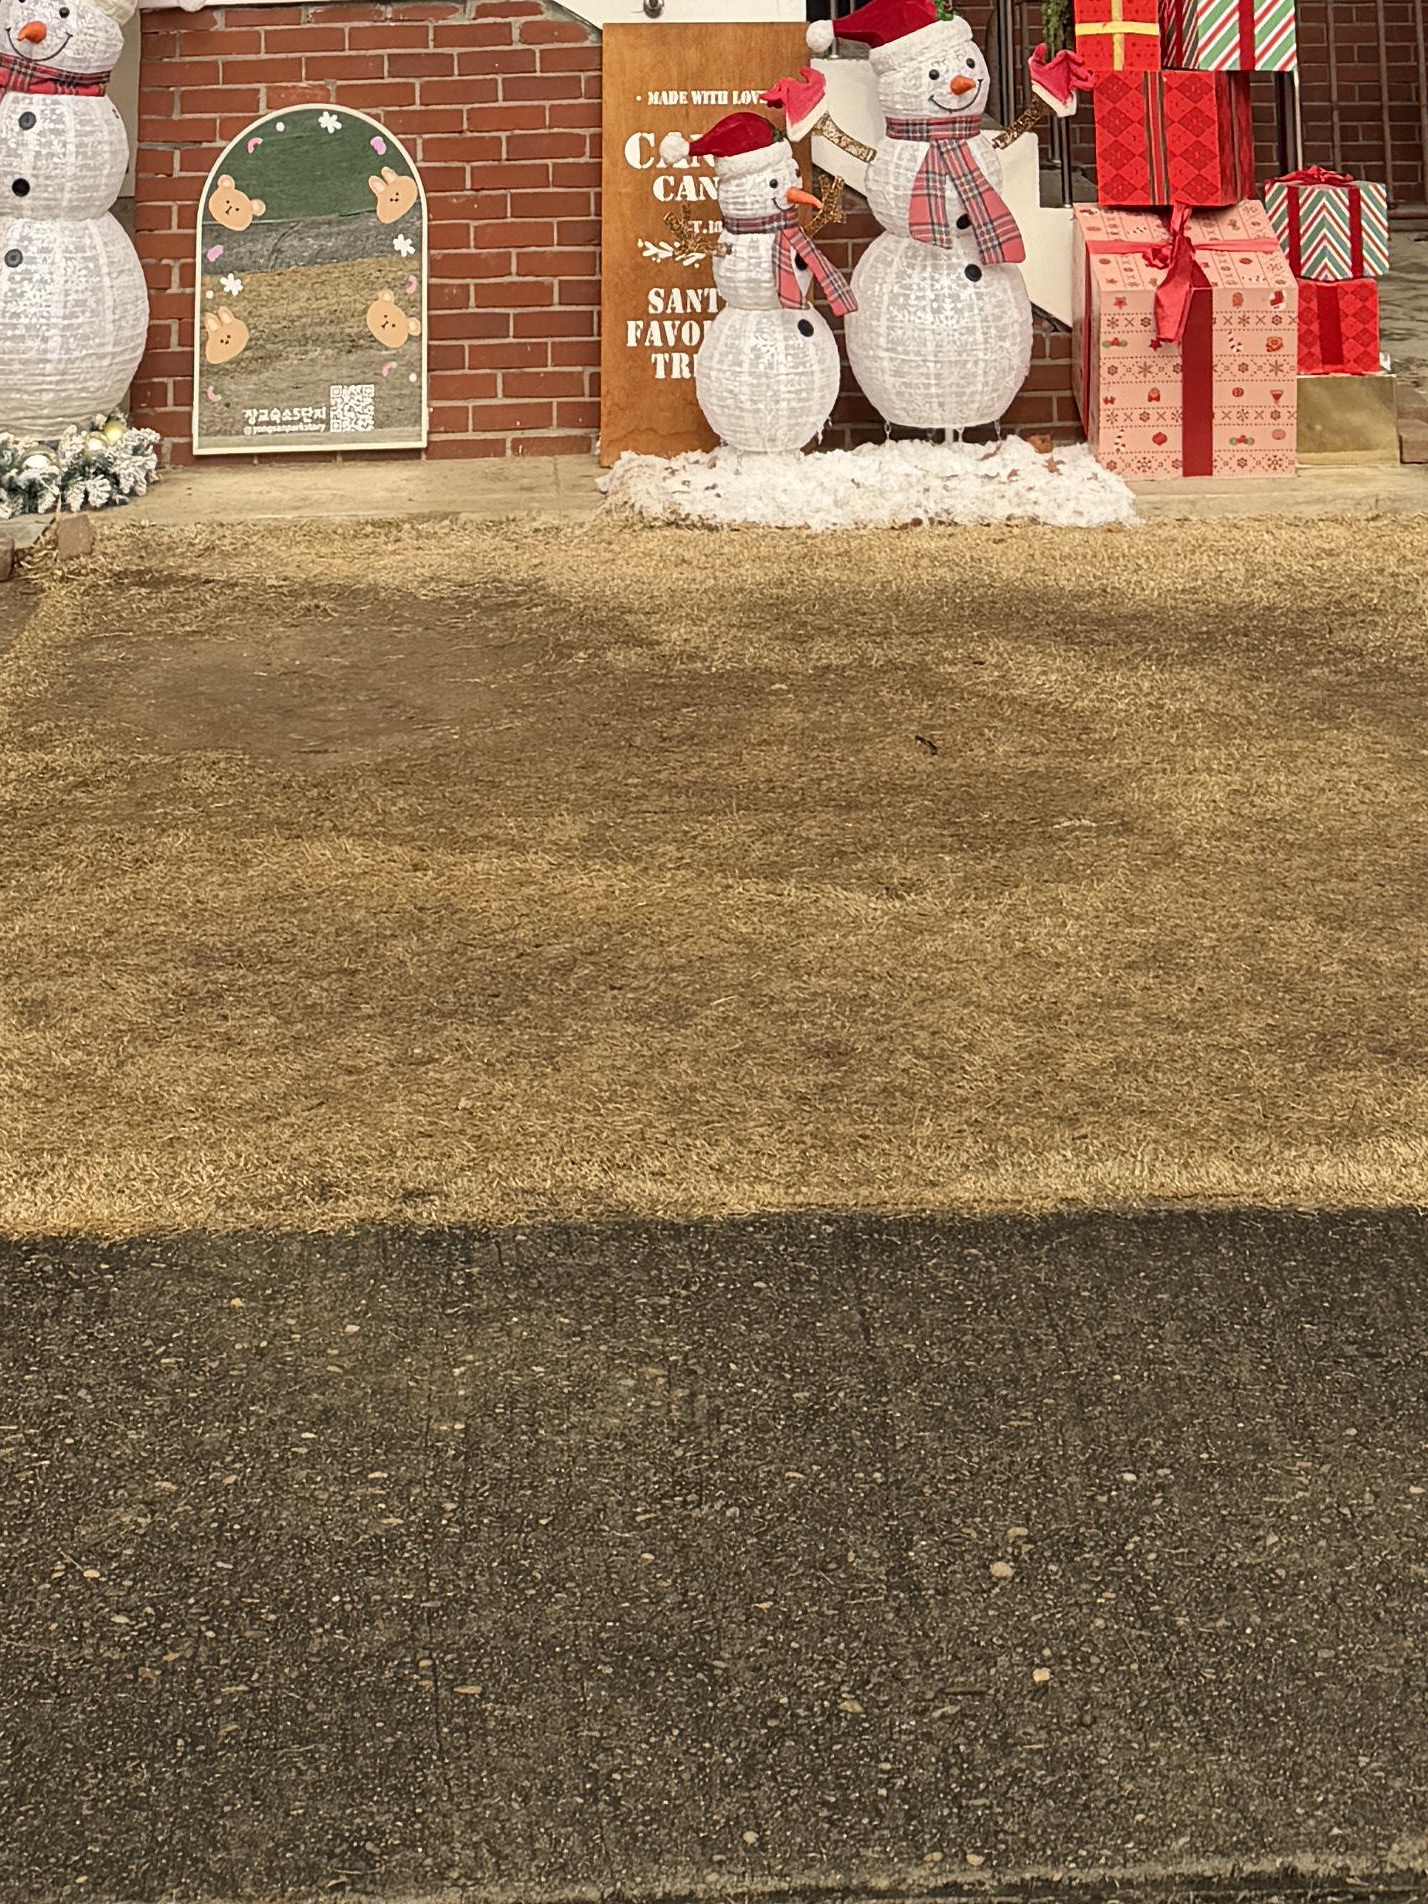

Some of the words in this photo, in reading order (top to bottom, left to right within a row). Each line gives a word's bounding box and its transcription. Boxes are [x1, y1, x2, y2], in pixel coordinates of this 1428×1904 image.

[648, 90, 688, 106] MADE
[691, 90, 728, 106] WITH
[626, 320, 710, 347] FAVO
[651, 353, 696, 379] TR
[241, 406, 327, 425] 장교숙소5단지
